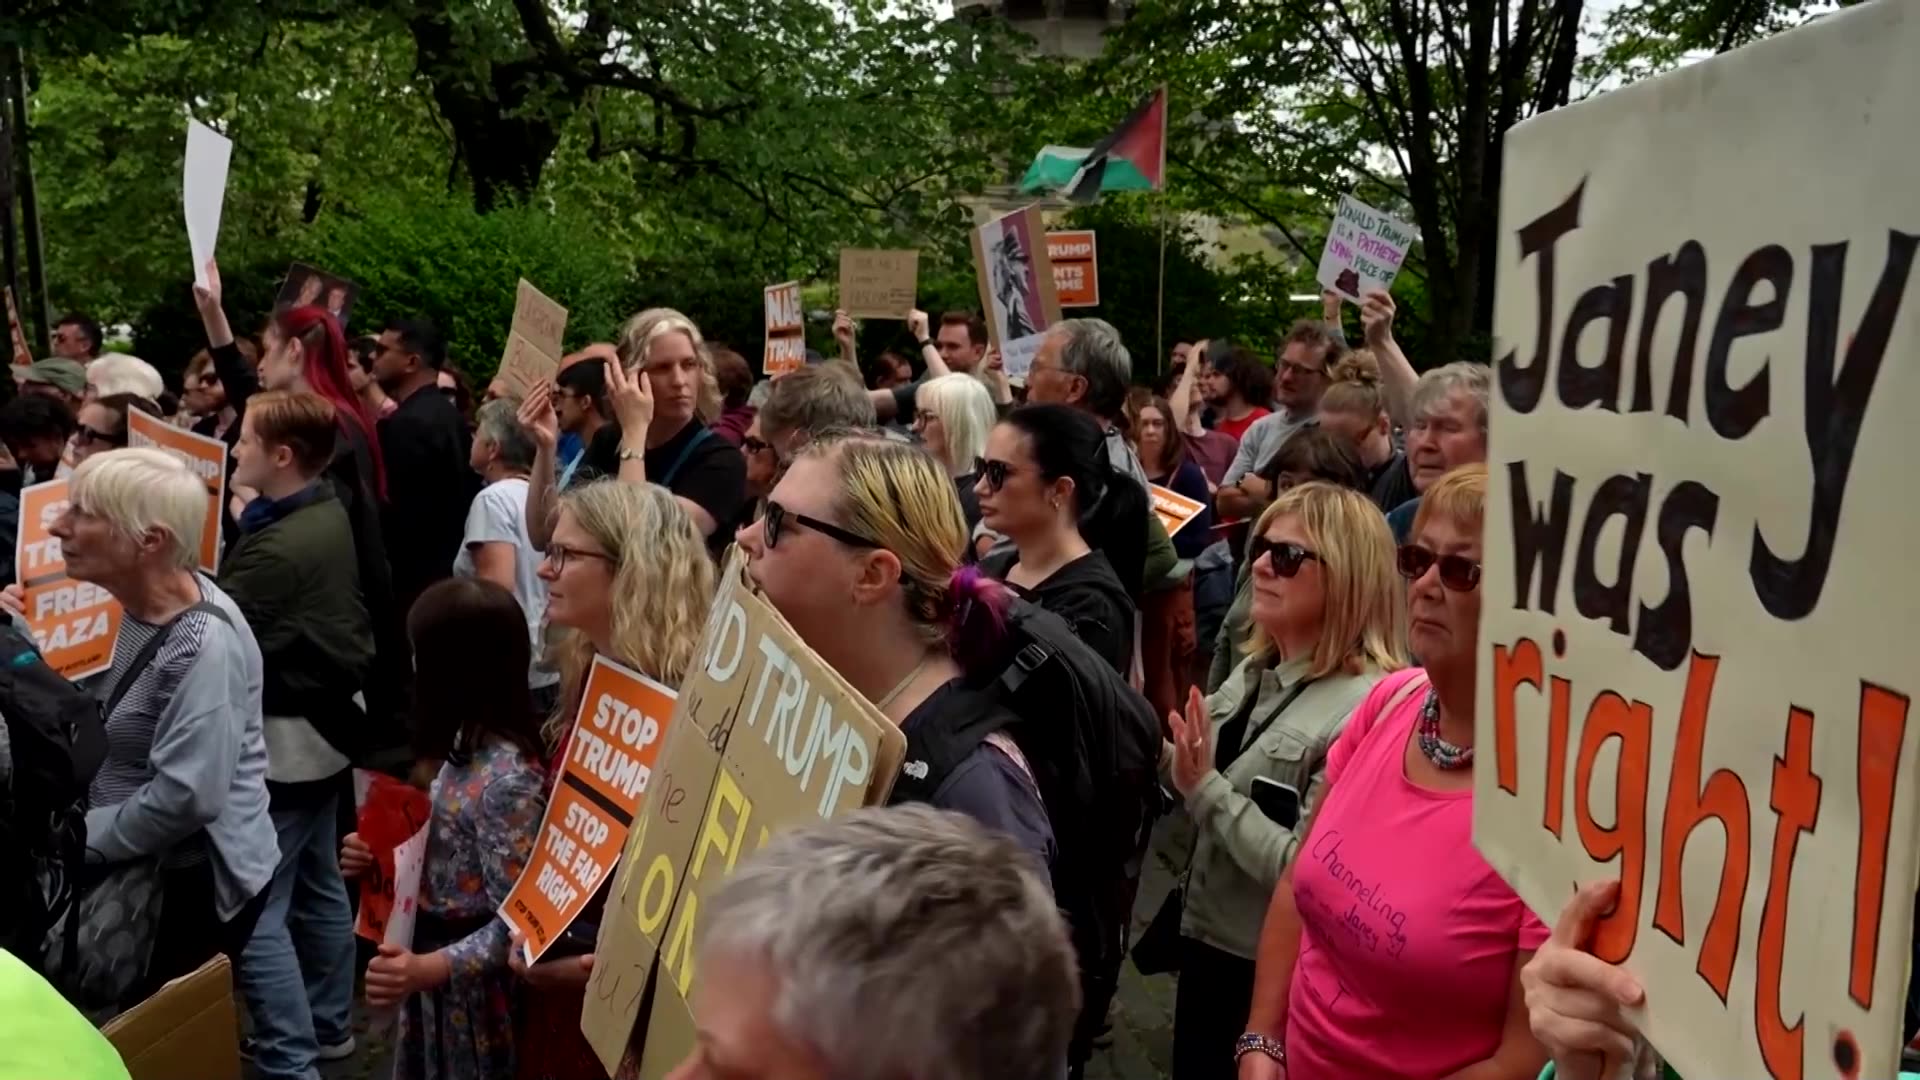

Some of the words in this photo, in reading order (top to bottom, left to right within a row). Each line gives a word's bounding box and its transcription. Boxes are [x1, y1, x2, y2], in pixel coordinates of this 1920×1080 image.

[1339, 196, 1376, 231] DONALD
[1047, 243, 1091, 257] RUMP
[1053, 266, 1084, 280] NTS
[1498, 173, 1920, 621] Janey
[1506, 460, 1720, 672] was
[593, 693, 659, 752] STOP
[747, 632, 869, 820] TRUMP
[573, 727, 651, 799] TRUMP
[545, 823, 576, 868] THE
[570, 849, 602, 893] FAR
[564, 801, 609, 848] STOP
[1492, 630, 1911, 1080] right!
[535, 861, 578, 916] RIGHT
[1312, 830, 1407, 940] Channeling
